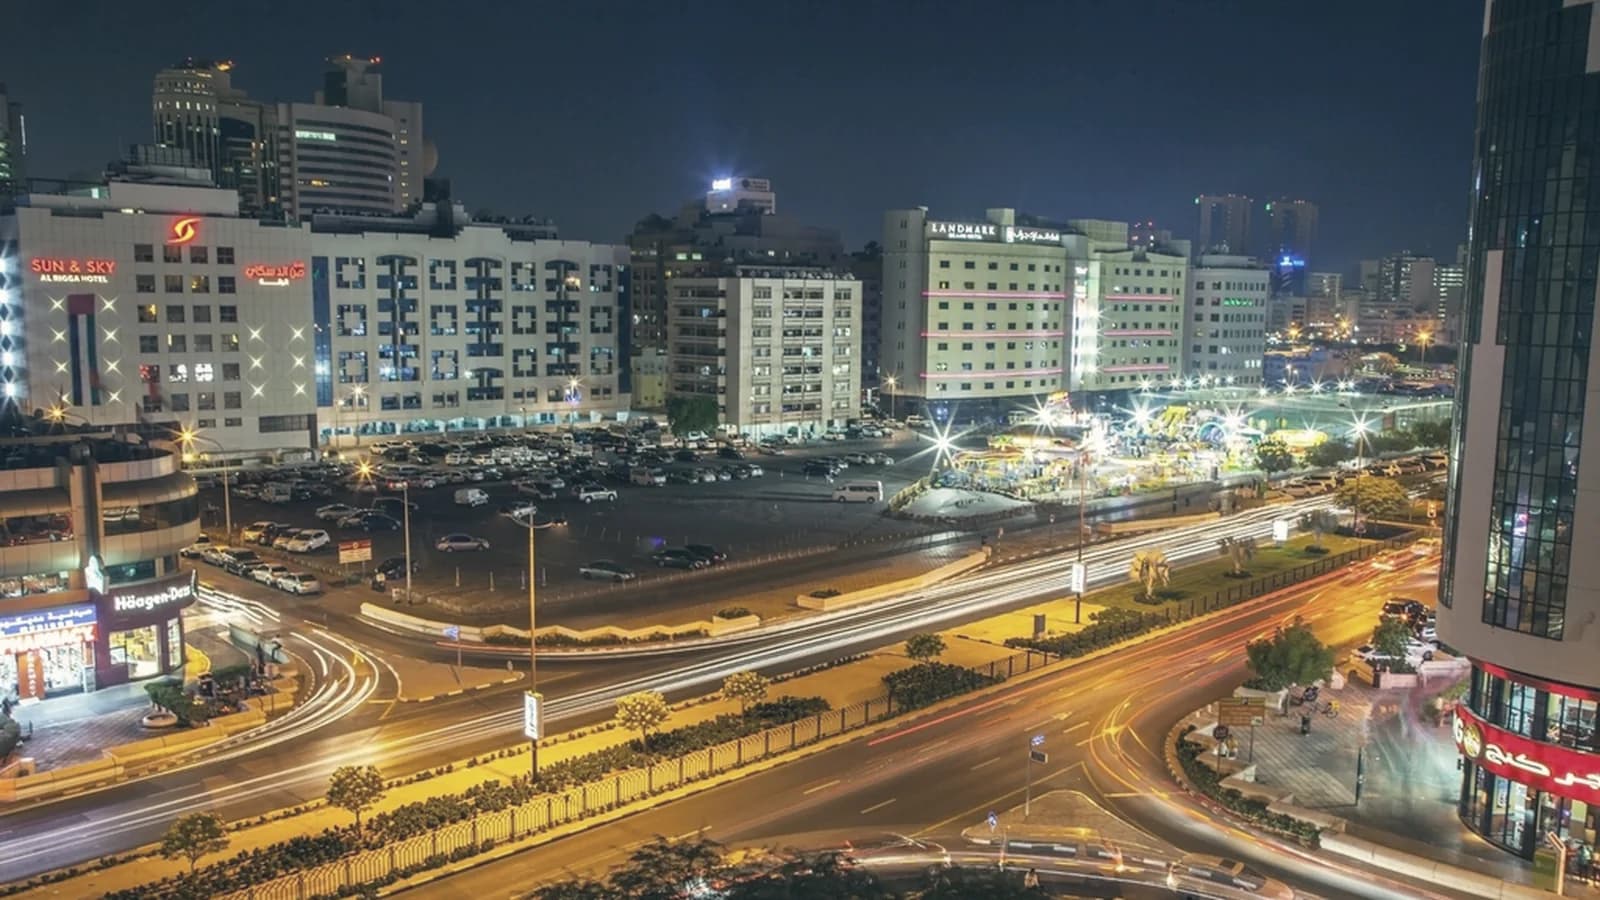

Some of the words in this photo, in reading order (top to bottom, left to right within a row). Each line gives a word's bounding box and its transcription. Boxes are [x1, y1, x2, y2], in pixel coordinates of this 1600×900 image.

[932, 223, 996, 235] LANDMARK
[31, 259, 65, 272] SUN
[69, 260, 81, 272] &
[86, 260, 115, 273] SKY
[40, 274, 53, 282] AL
[81, 275, 108, 283] HOTEL
